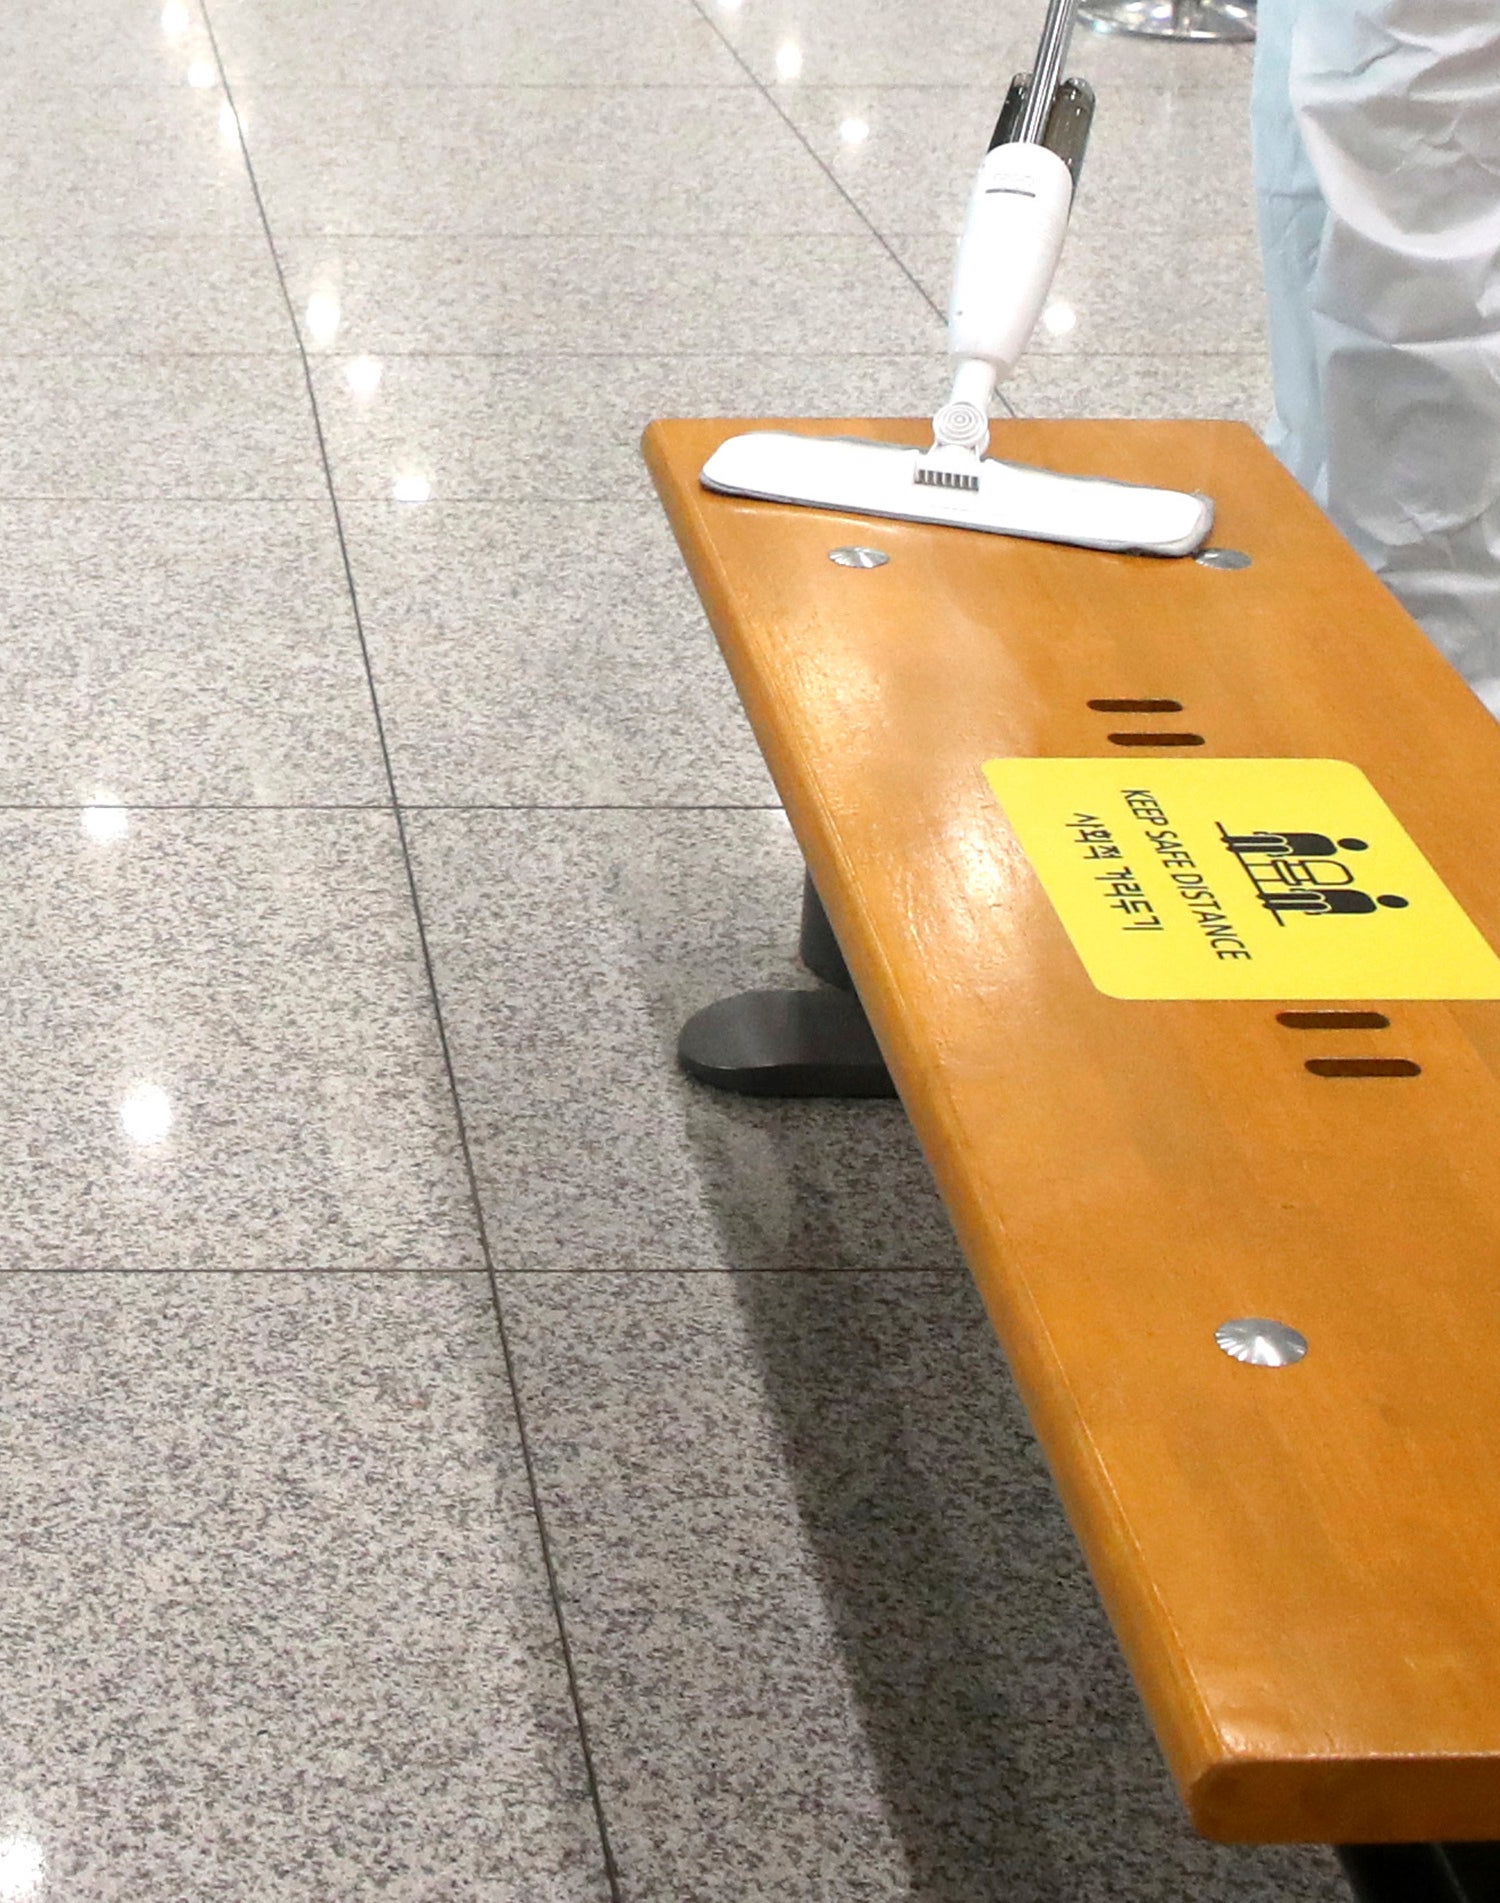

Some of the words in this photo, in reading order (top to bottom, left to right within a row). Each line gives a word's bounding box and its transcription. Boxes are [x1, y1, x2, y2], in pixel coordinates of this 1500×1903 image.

[1120, 789, 1170, 827] KEEP
[1065, 812, 1124, 860] 사회적
[1145, 830, 1197, 869] SAFE
[1094, 866, 1165, 931] 거리두기
[1170, 873, 1253, 961] DISTANCE
